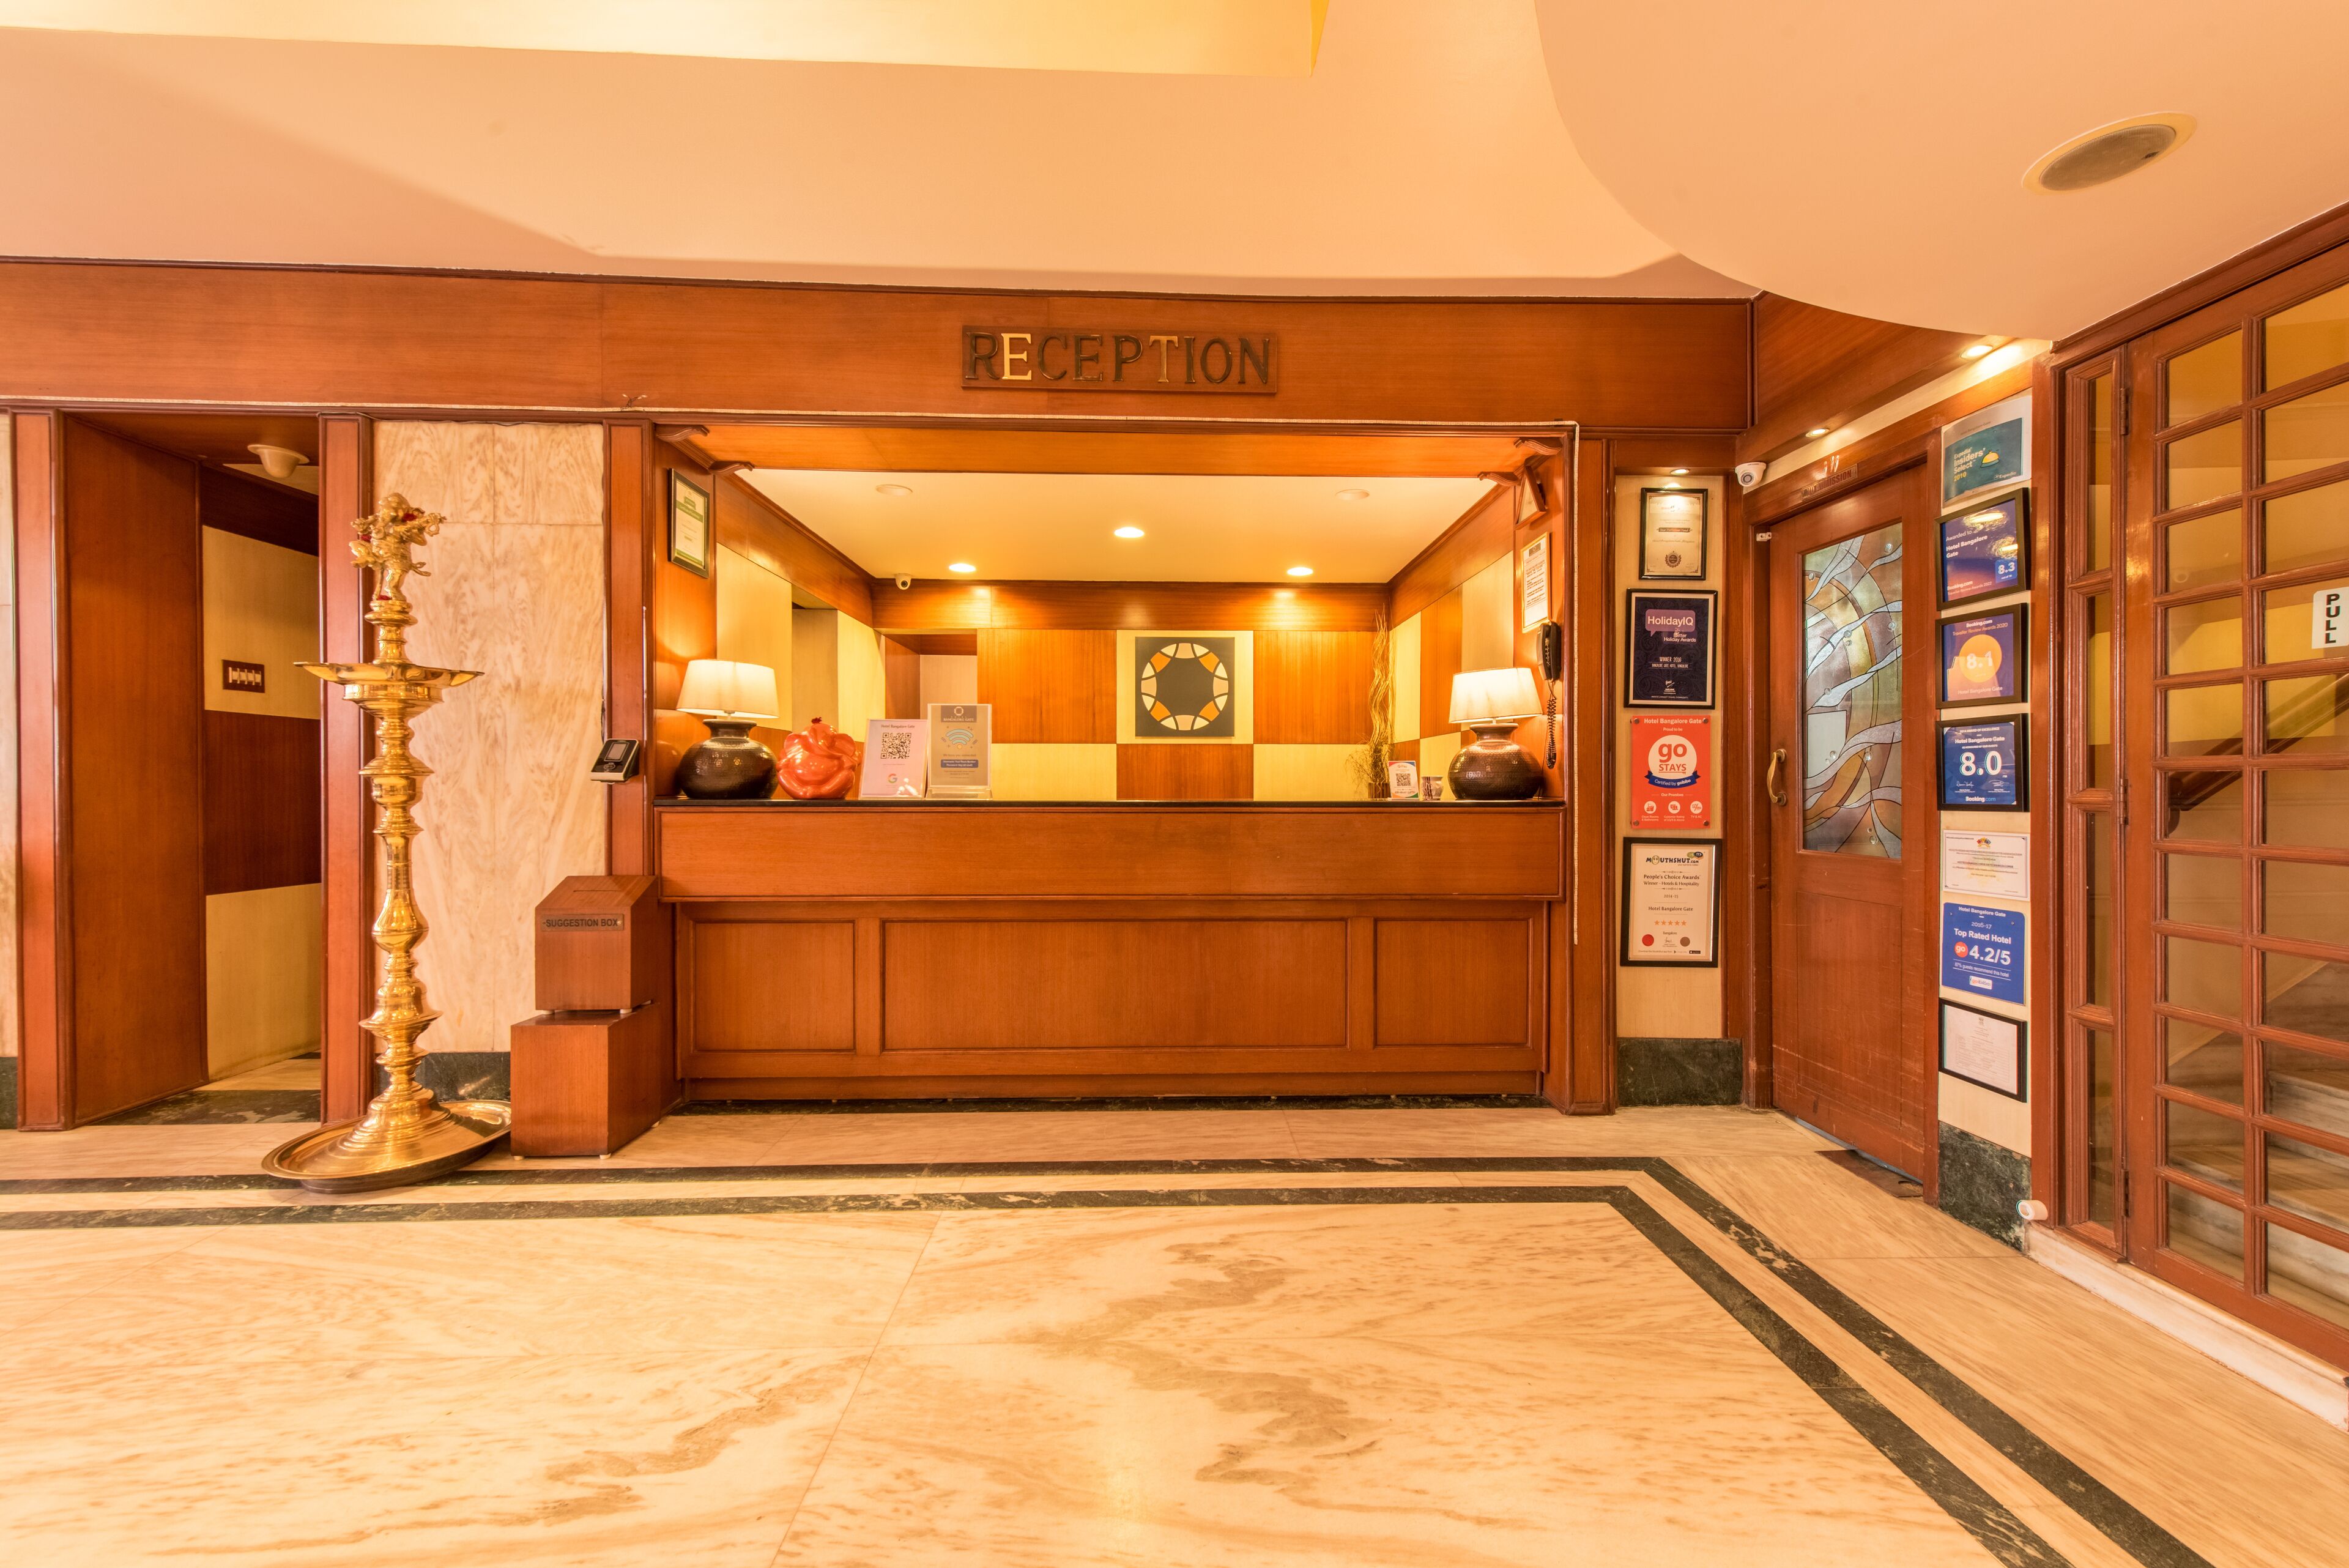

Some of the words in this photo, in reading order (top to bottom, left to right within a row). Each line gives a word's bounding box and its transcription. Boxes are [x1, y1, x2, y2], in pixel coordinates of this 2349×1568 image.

[965, 332, 1269, 384] RECEPTION
[1954, 461, 1973, 474] Select
[1953, 471, 1967, 482] 2010
[1946, 531, 1966, 542] Awarded
[1946, 543, 1960, 552] Hotel
[1961, 535, 1987, 547] Bangalore
[1998, 562, 2016, 575] 8.3
[1947, 581, 1973, 590] Booking.com
[1647, 615, 1694, 627] HolidayIQ
[1966, 619, 1993, 628] Booking.com
[2325, 593, 2340, 644] PULL
[1966, 650, 1994, 670] 8.1
[1658, 743, 1687, 763] go
[1959, 750, 2002, 776] 8.0
[546, 919, 598, 927] SUGGESTION
[601, 918, 618, 927] BOX
[1954, 927, 1967, 938] Top
[1969, 930, 1989, 941] Rated
[1991, 934, 2011, 944] Hotel
[1969, 945, 2011, 965] 4.2/5
